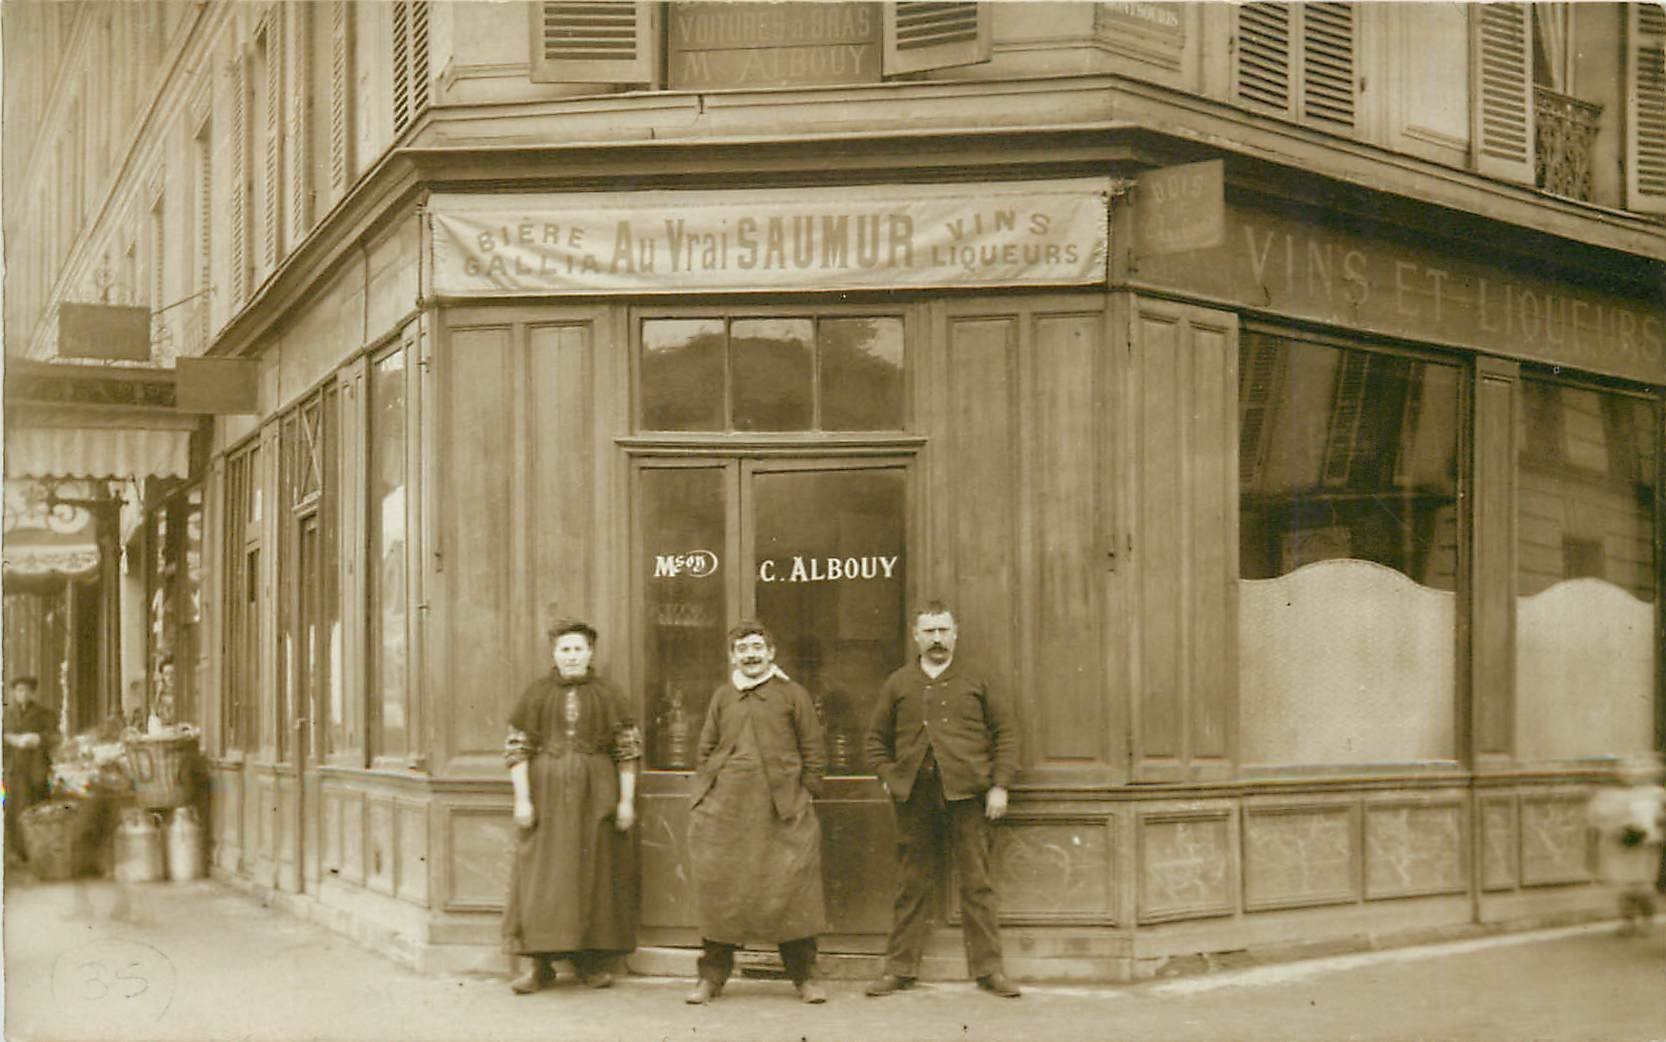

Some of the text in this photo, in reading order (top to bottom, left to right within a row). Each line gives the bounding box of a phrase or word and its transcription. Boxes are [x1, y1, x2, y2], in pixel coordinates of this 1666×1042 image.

[946, 209, 1051, 240] VINS
[609, 213, 914, 273] Au Vrai SAUMUR
[464, 254, 602, 277] GALLIA
[931, 244, 1079, 272] LIQUEURS
[1244, 226, 1664, 363] VINS ET LIQUEURS
[789, 556, 898, 582] ALBOUY
